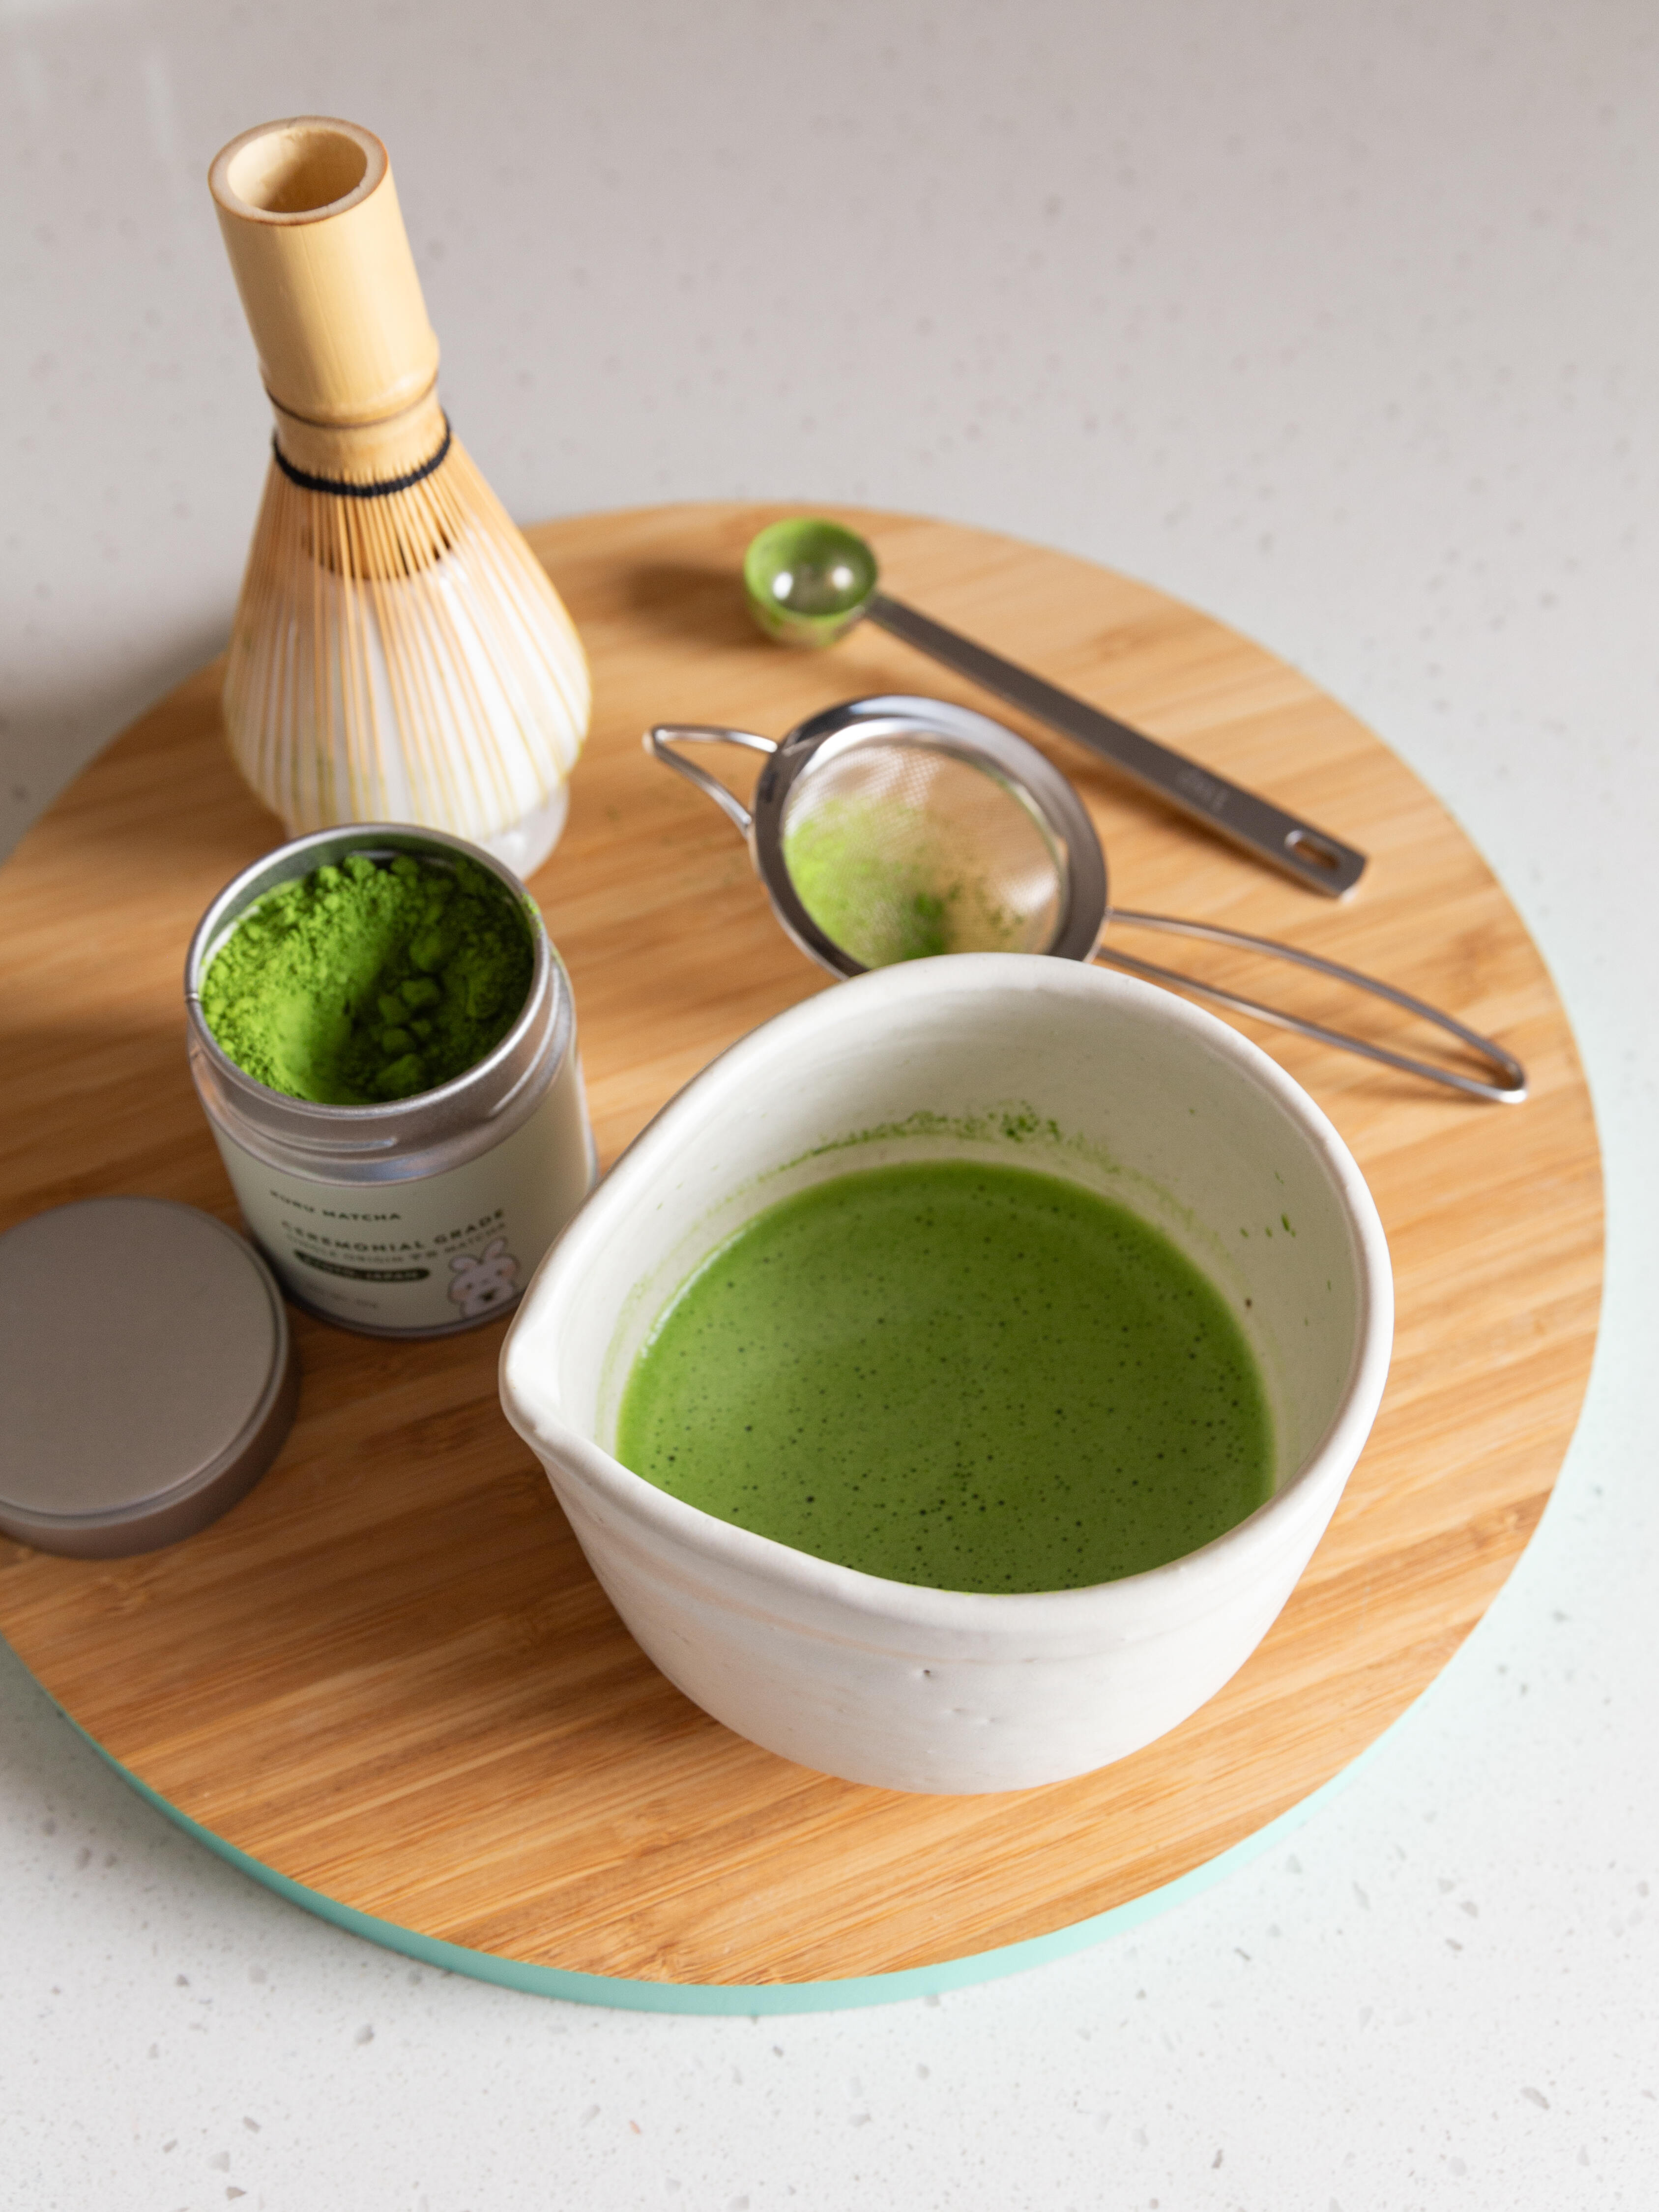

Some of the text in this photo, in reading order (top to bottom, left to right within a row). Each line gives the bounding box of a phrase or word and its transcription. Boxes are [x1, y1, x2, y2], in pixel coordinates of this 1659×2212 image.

[281, 1208, 504, 1252] CEREMONIAL GRADE
[322, 1210, 401, 1222] MATCHA
